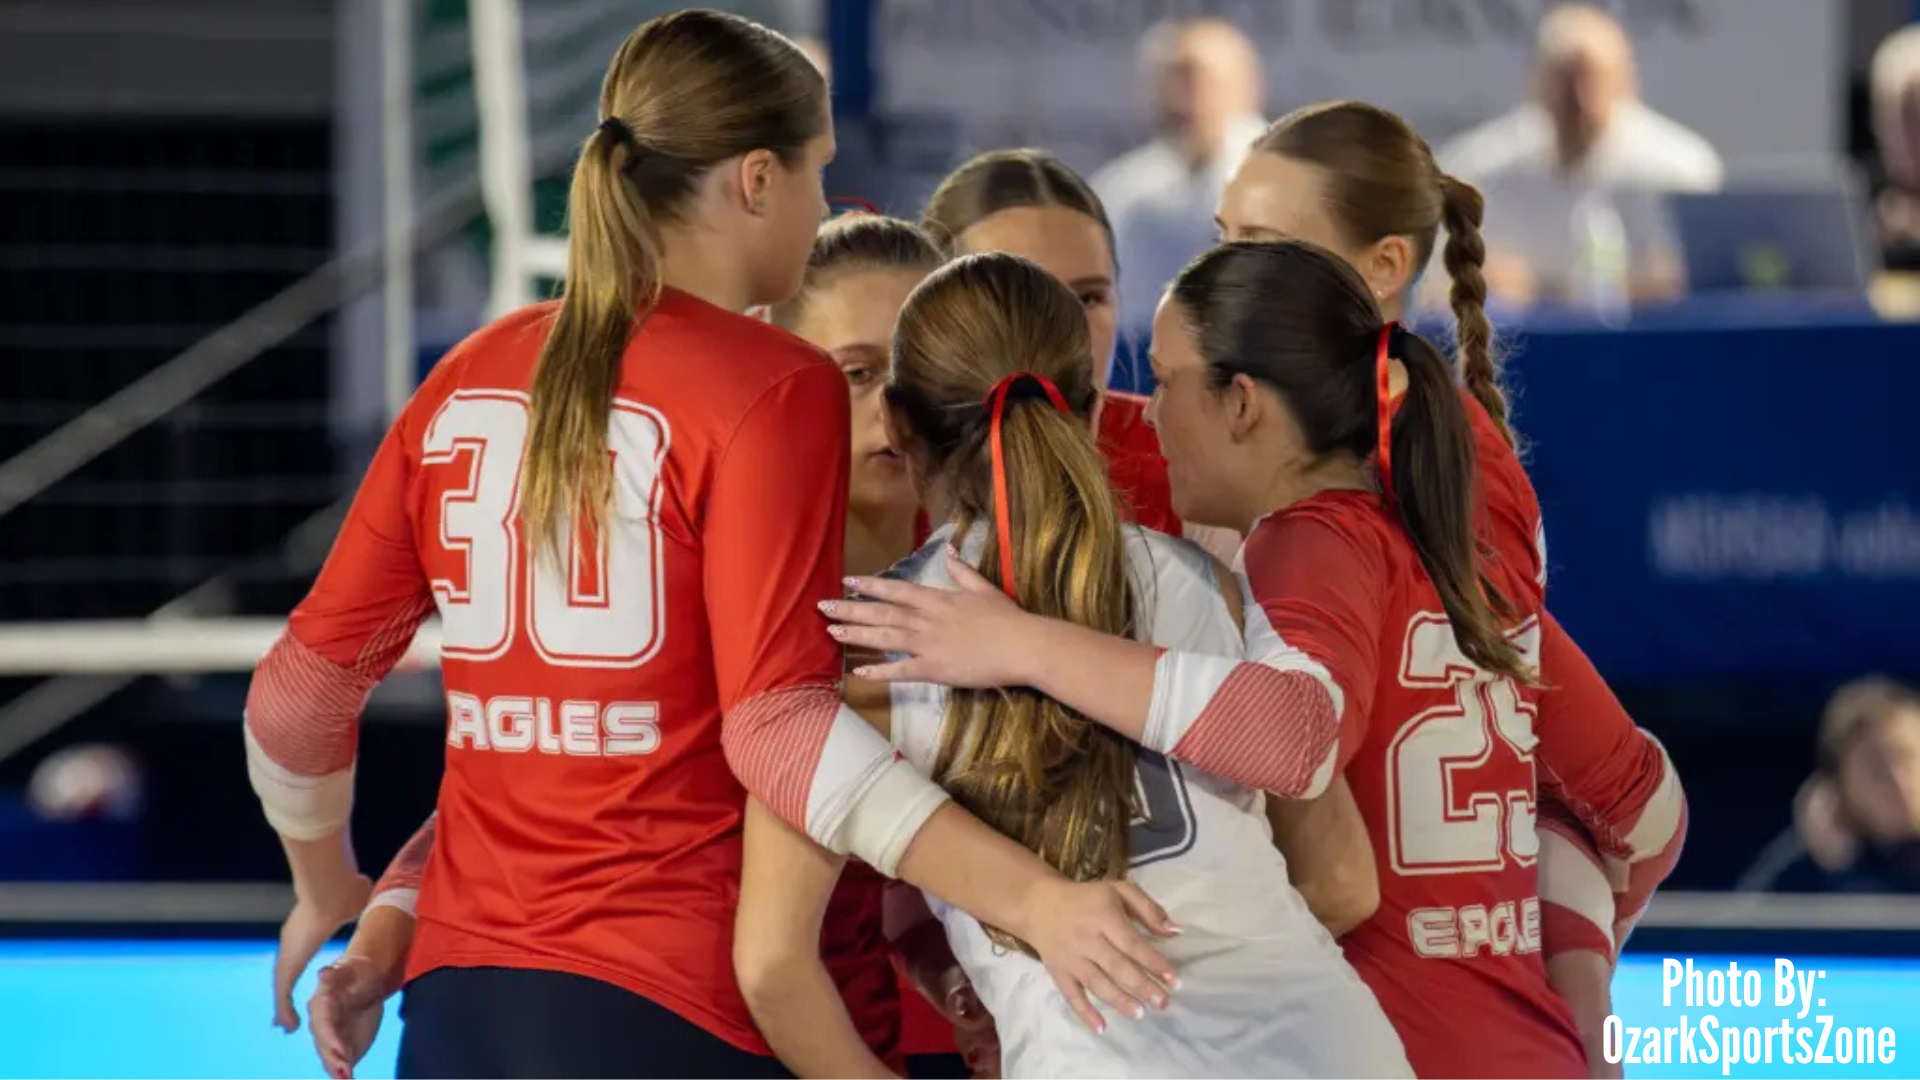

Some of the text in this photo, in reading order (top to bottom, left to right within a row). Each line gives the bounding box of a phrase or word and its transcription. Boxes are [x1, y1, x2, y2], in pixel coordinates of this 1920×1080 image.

[421, 387, 672, 669] 30
[447, 689, 661, 756] AGLES
[1406, 896, 1543, 959] EAGLE
